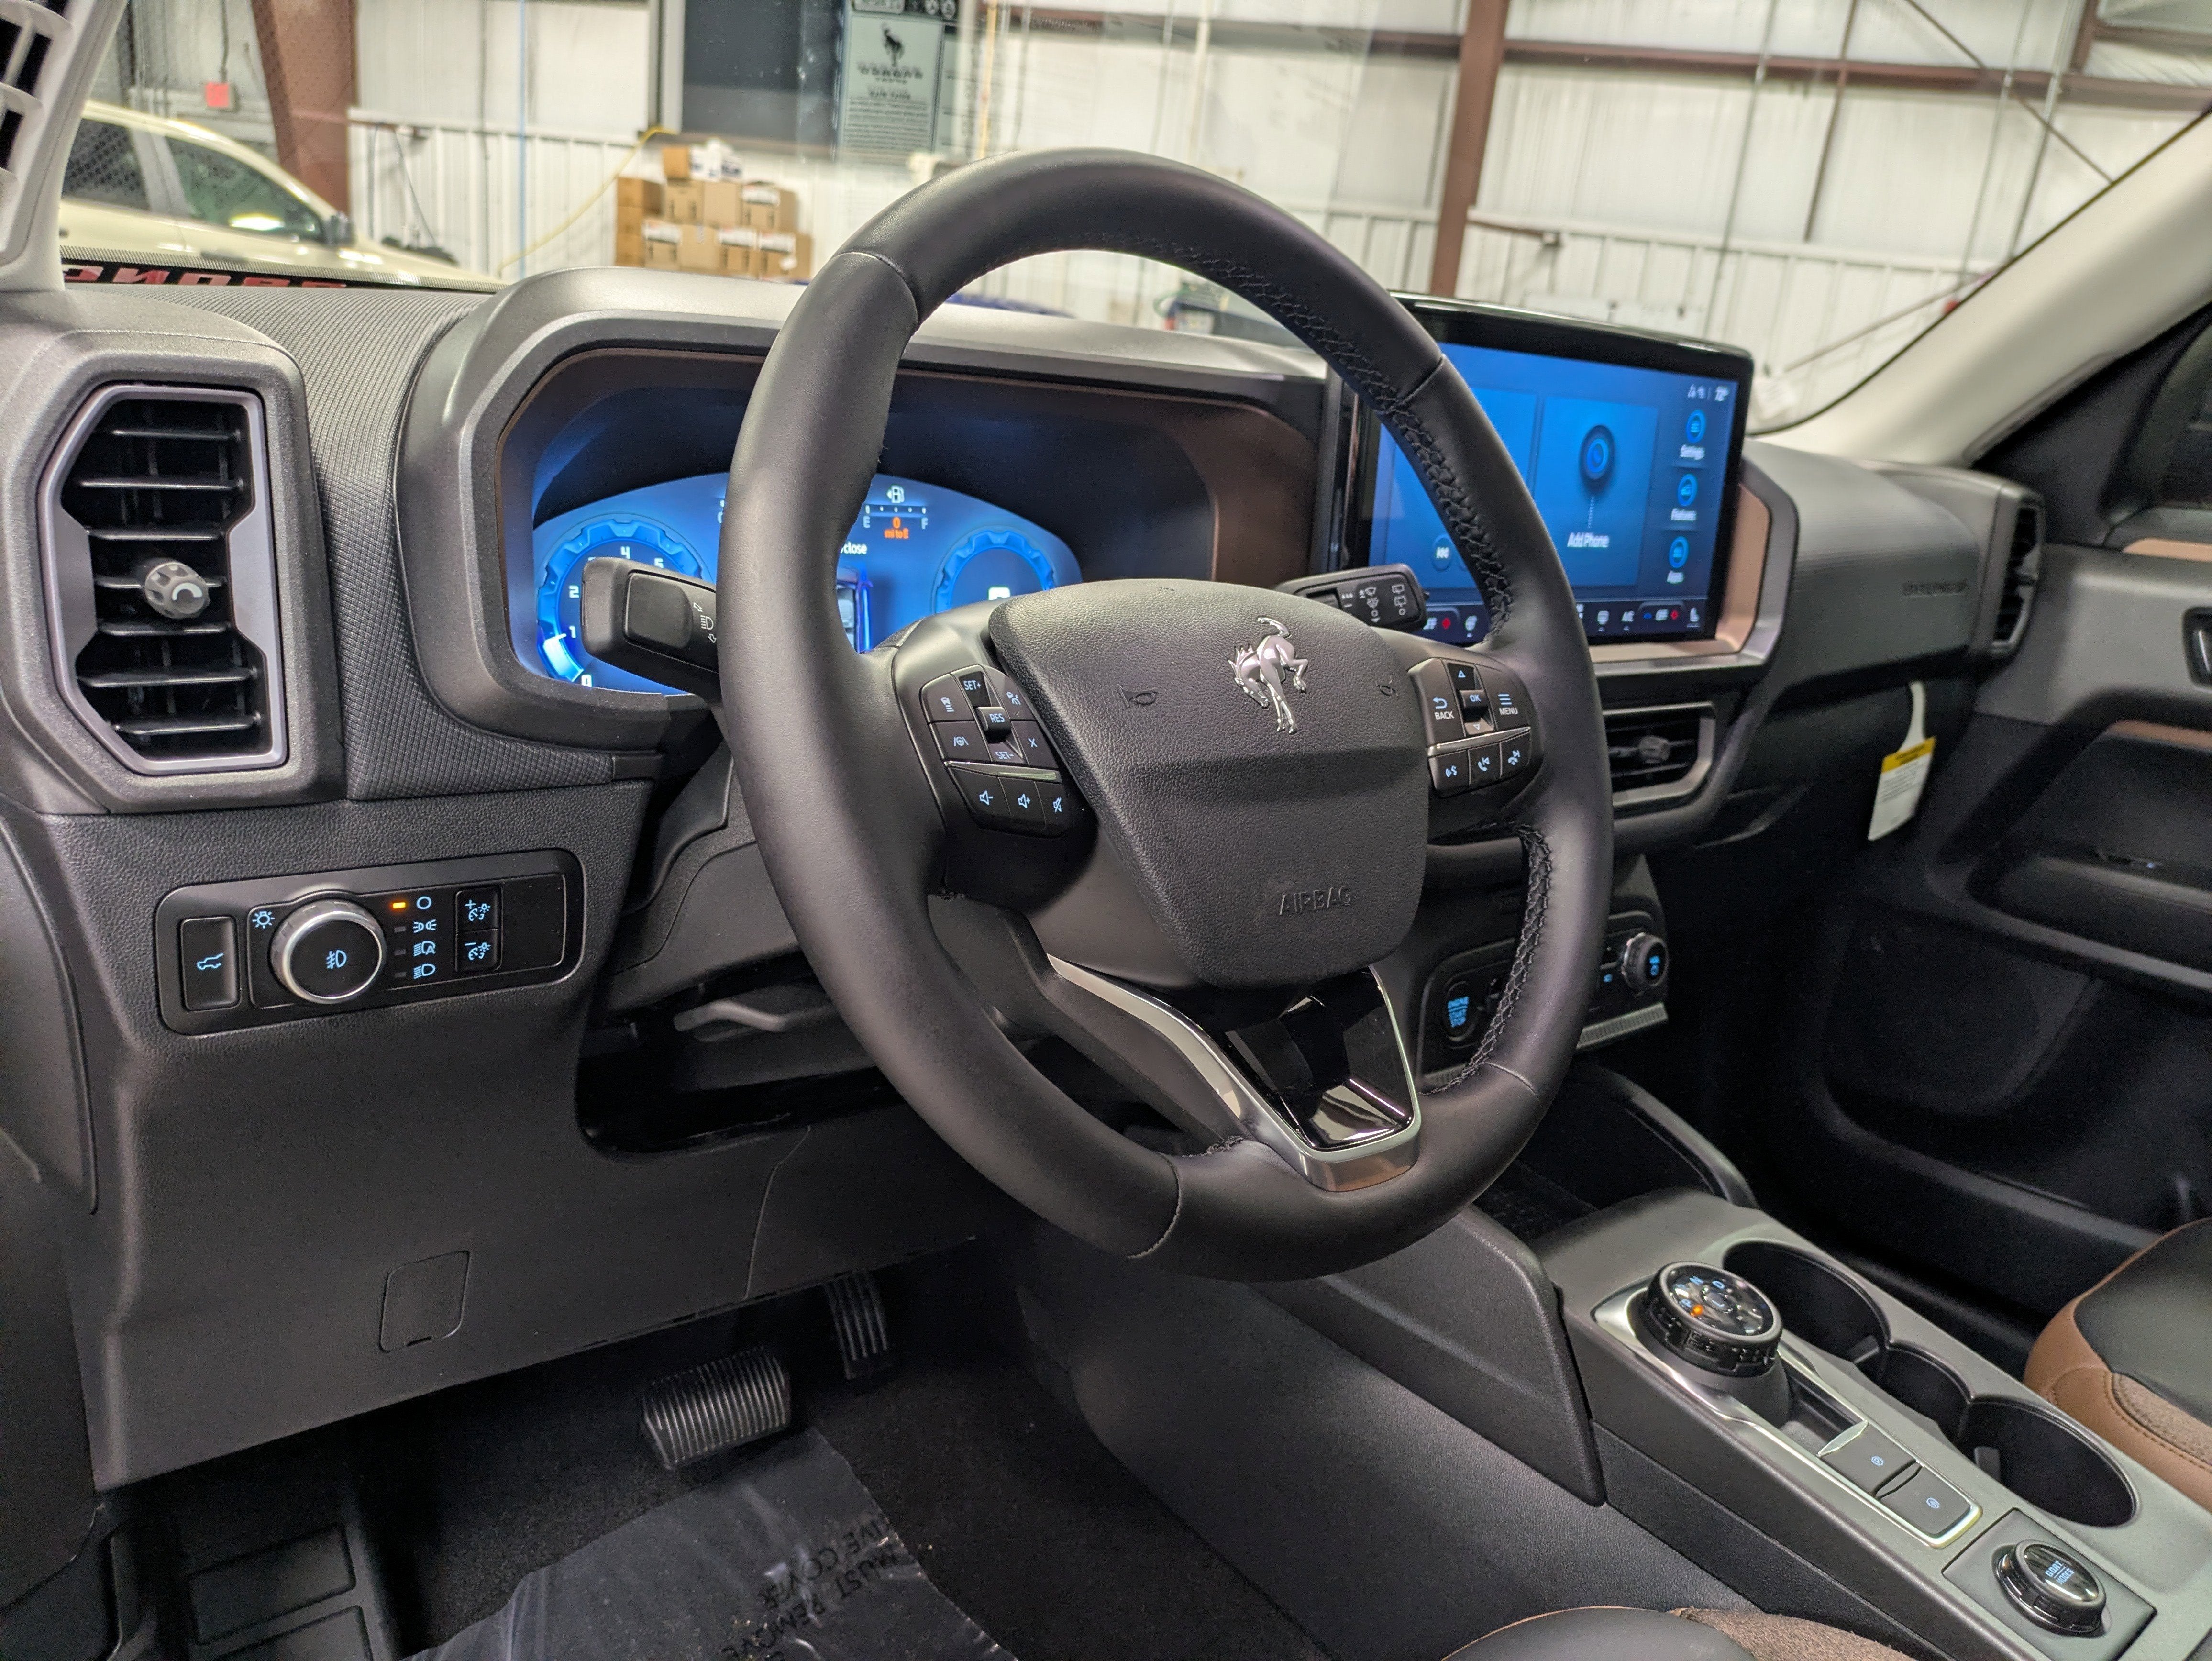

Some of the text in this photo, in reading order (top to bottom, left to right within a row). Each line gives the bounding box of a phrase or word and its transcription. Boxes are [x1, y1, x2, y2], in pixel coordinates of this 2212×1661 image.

[863, 516, 870, 528] E
[893, 517, 900, 528] 0
[921, 518, 928, 529] F
[568, 586, 579, 598] 2
[569, 626, 576, 638] 1
[1469, 694, 1481, 703] OK
[1434, 711, 1454, 720] BACK
[1499, 707, 1518, 715] MENU
[989, 713, 1005, 723] RES
[1278, 885, 1352, 915] AIRBAG
[2056, 1567, 2075, 1585] MODES
